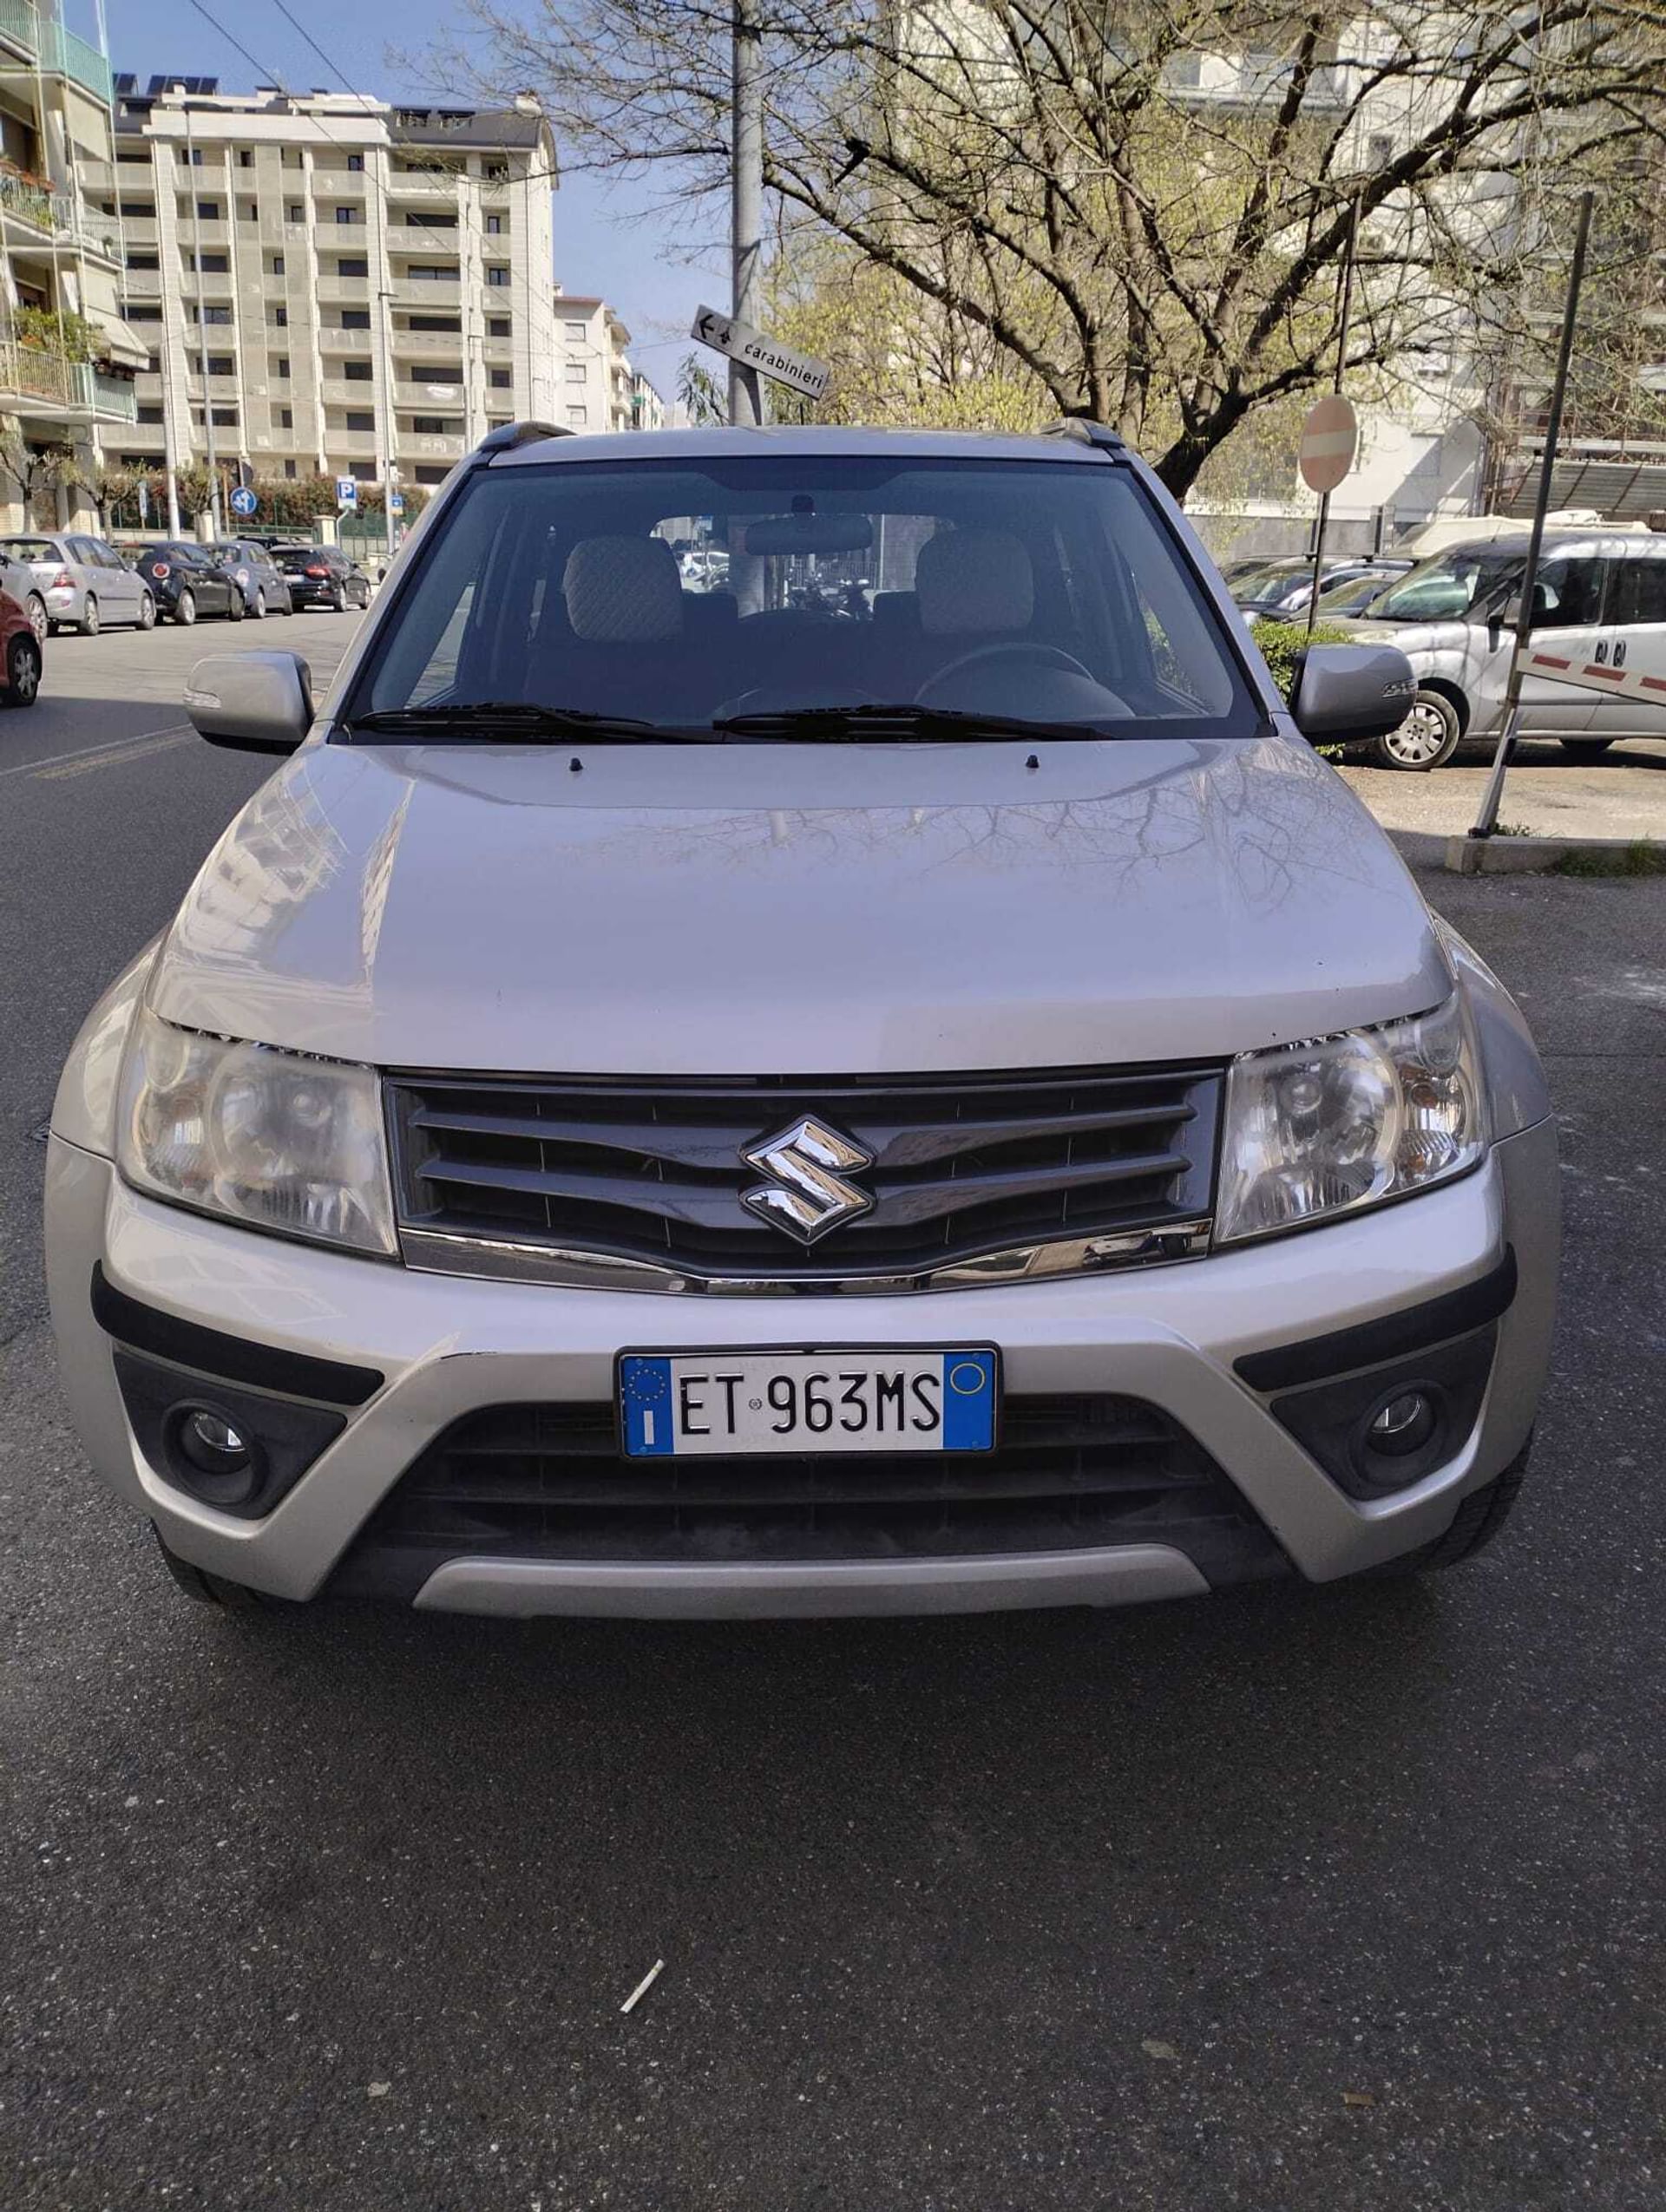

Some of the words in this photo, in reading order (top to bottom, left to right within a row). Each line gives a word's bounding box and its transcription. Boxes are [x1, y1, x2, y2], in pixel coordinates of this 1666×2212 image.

[744, 344, 823, 389] carabinieri
[340, 482, 352, 497] P
[679, 1372, 744, 1435] ET
[767, 1371, 941, 1434] 963MS
[644, 1410, 655, 1445] I
